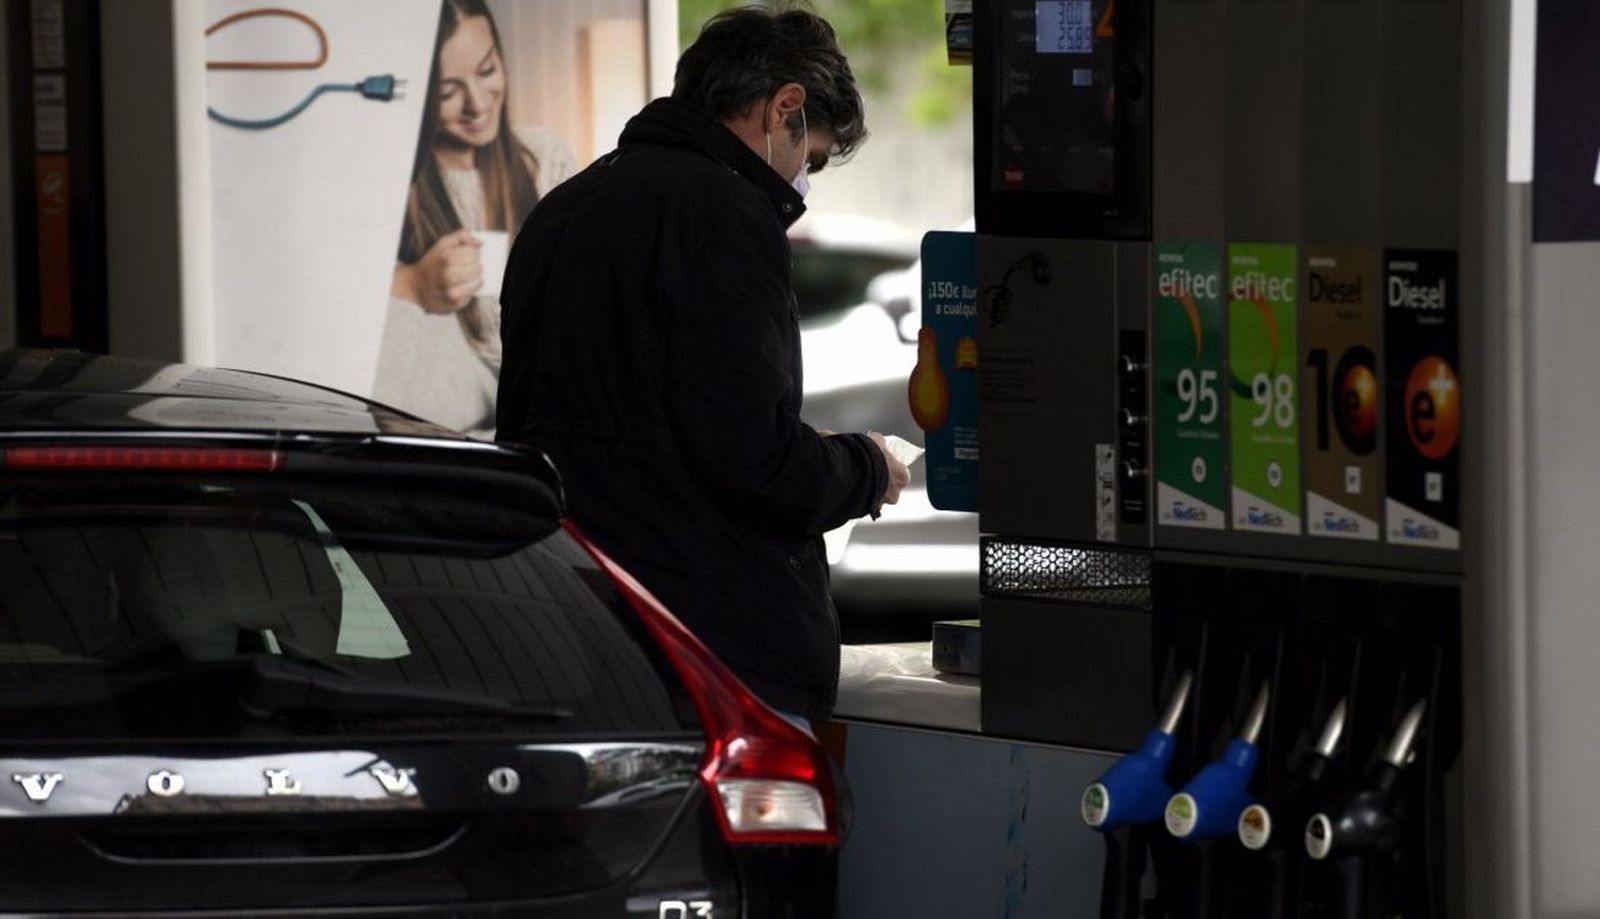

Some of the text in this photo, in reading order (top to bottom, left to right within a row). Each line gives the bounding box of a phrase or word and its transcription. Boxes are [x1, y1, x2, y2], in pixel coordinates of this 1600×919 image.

[1158, 268, 1220, 299] efitec
[1232, 271, 1295, 302] efitec
[1309, 271, 1362, 304] Diesel
[1388, 275, 1446, 310] Diesel
[1177, 367, 1219, 424] 95
[1251, 372, 1295, 428] 98
[12, 766, 521, 803] VOLVO
